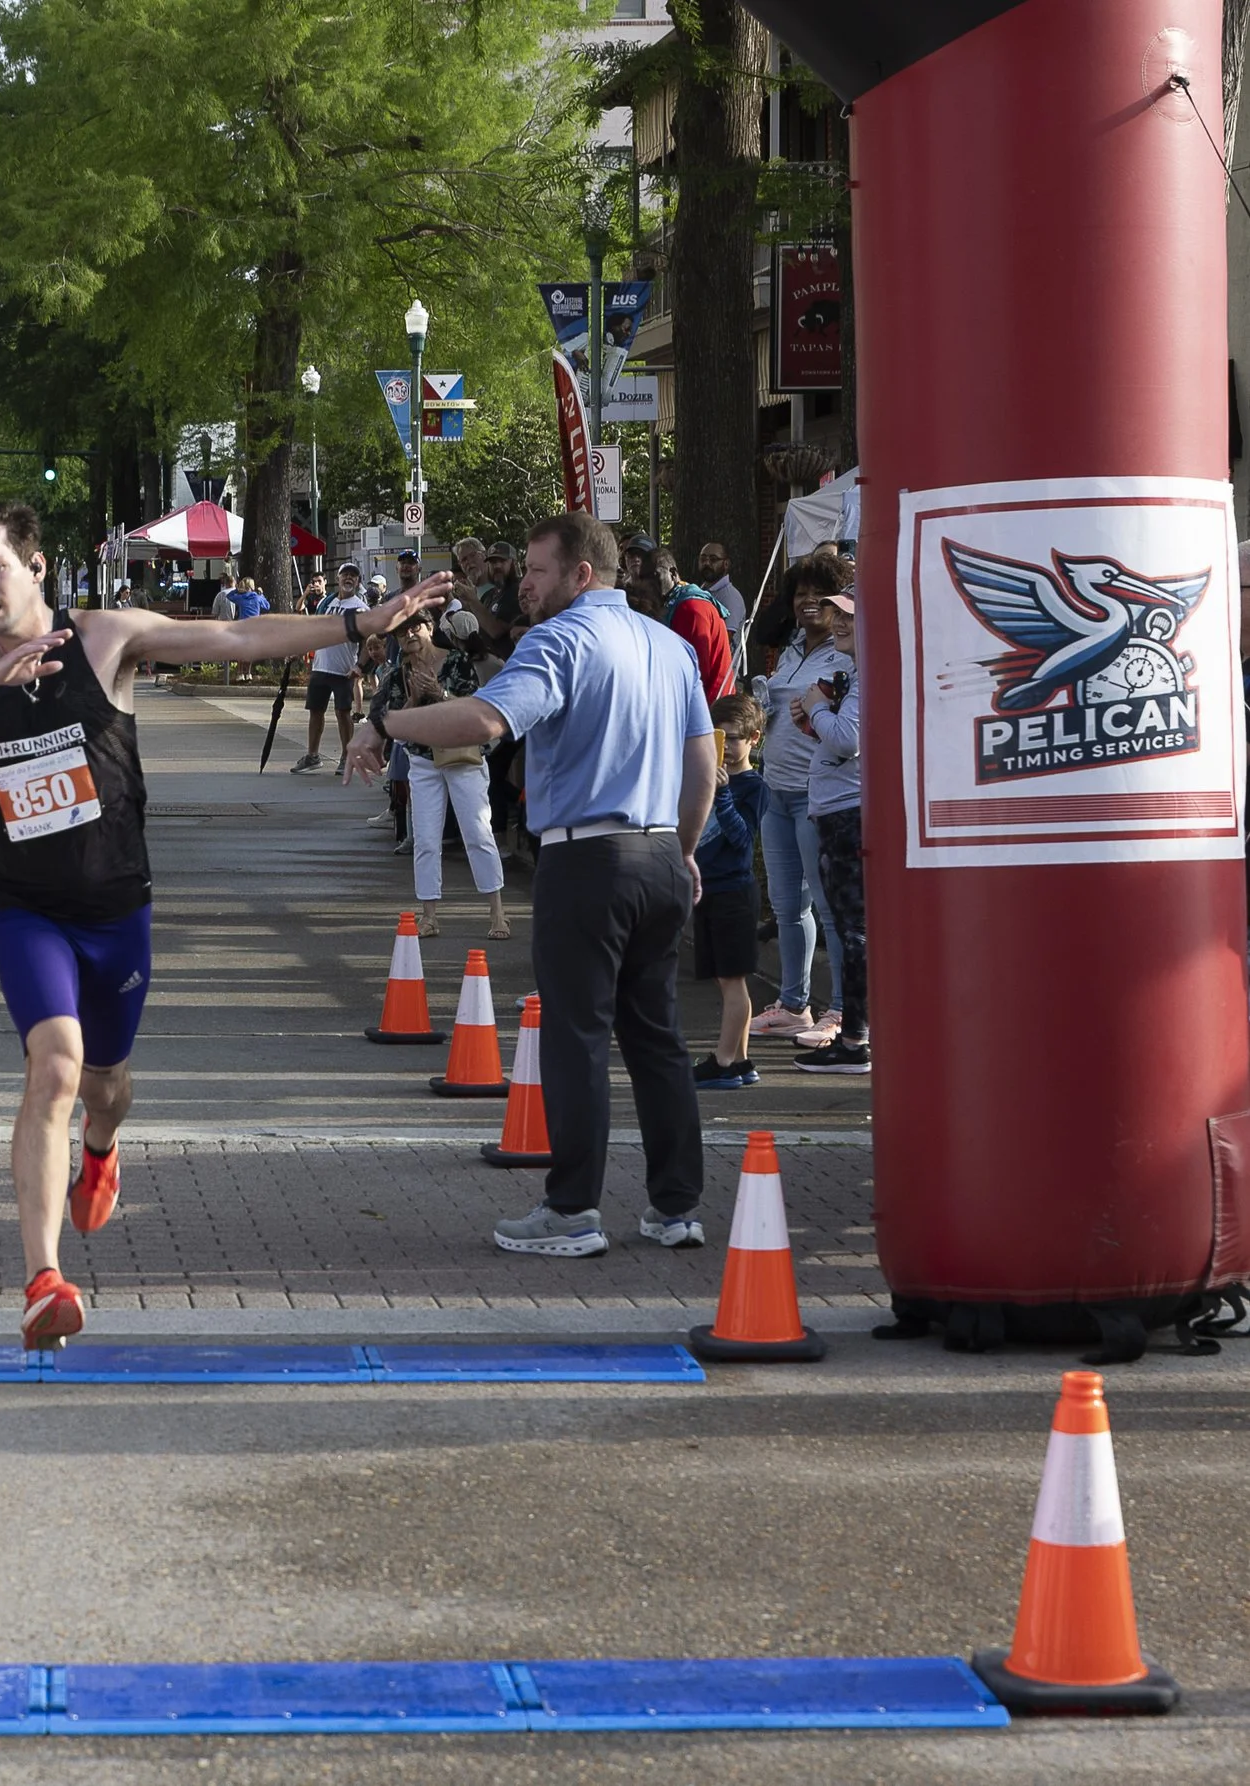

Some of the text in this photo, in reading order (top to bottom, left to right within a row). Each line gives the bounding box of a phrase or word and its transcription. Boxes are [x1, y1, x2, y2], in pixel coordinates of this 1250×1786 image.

[793, 282, 840, 300] PAMPL
[790, 343, 833, 352] TAPAS
[619, 392, 654, 401] DOZIER
[982, 693, 1196, 756] PELICAN
[11, 726, 81, 755] RUNNING
[1003, 733, 1184, 771] TIMING SERVICES
[9, 771, 77, 818] 850
